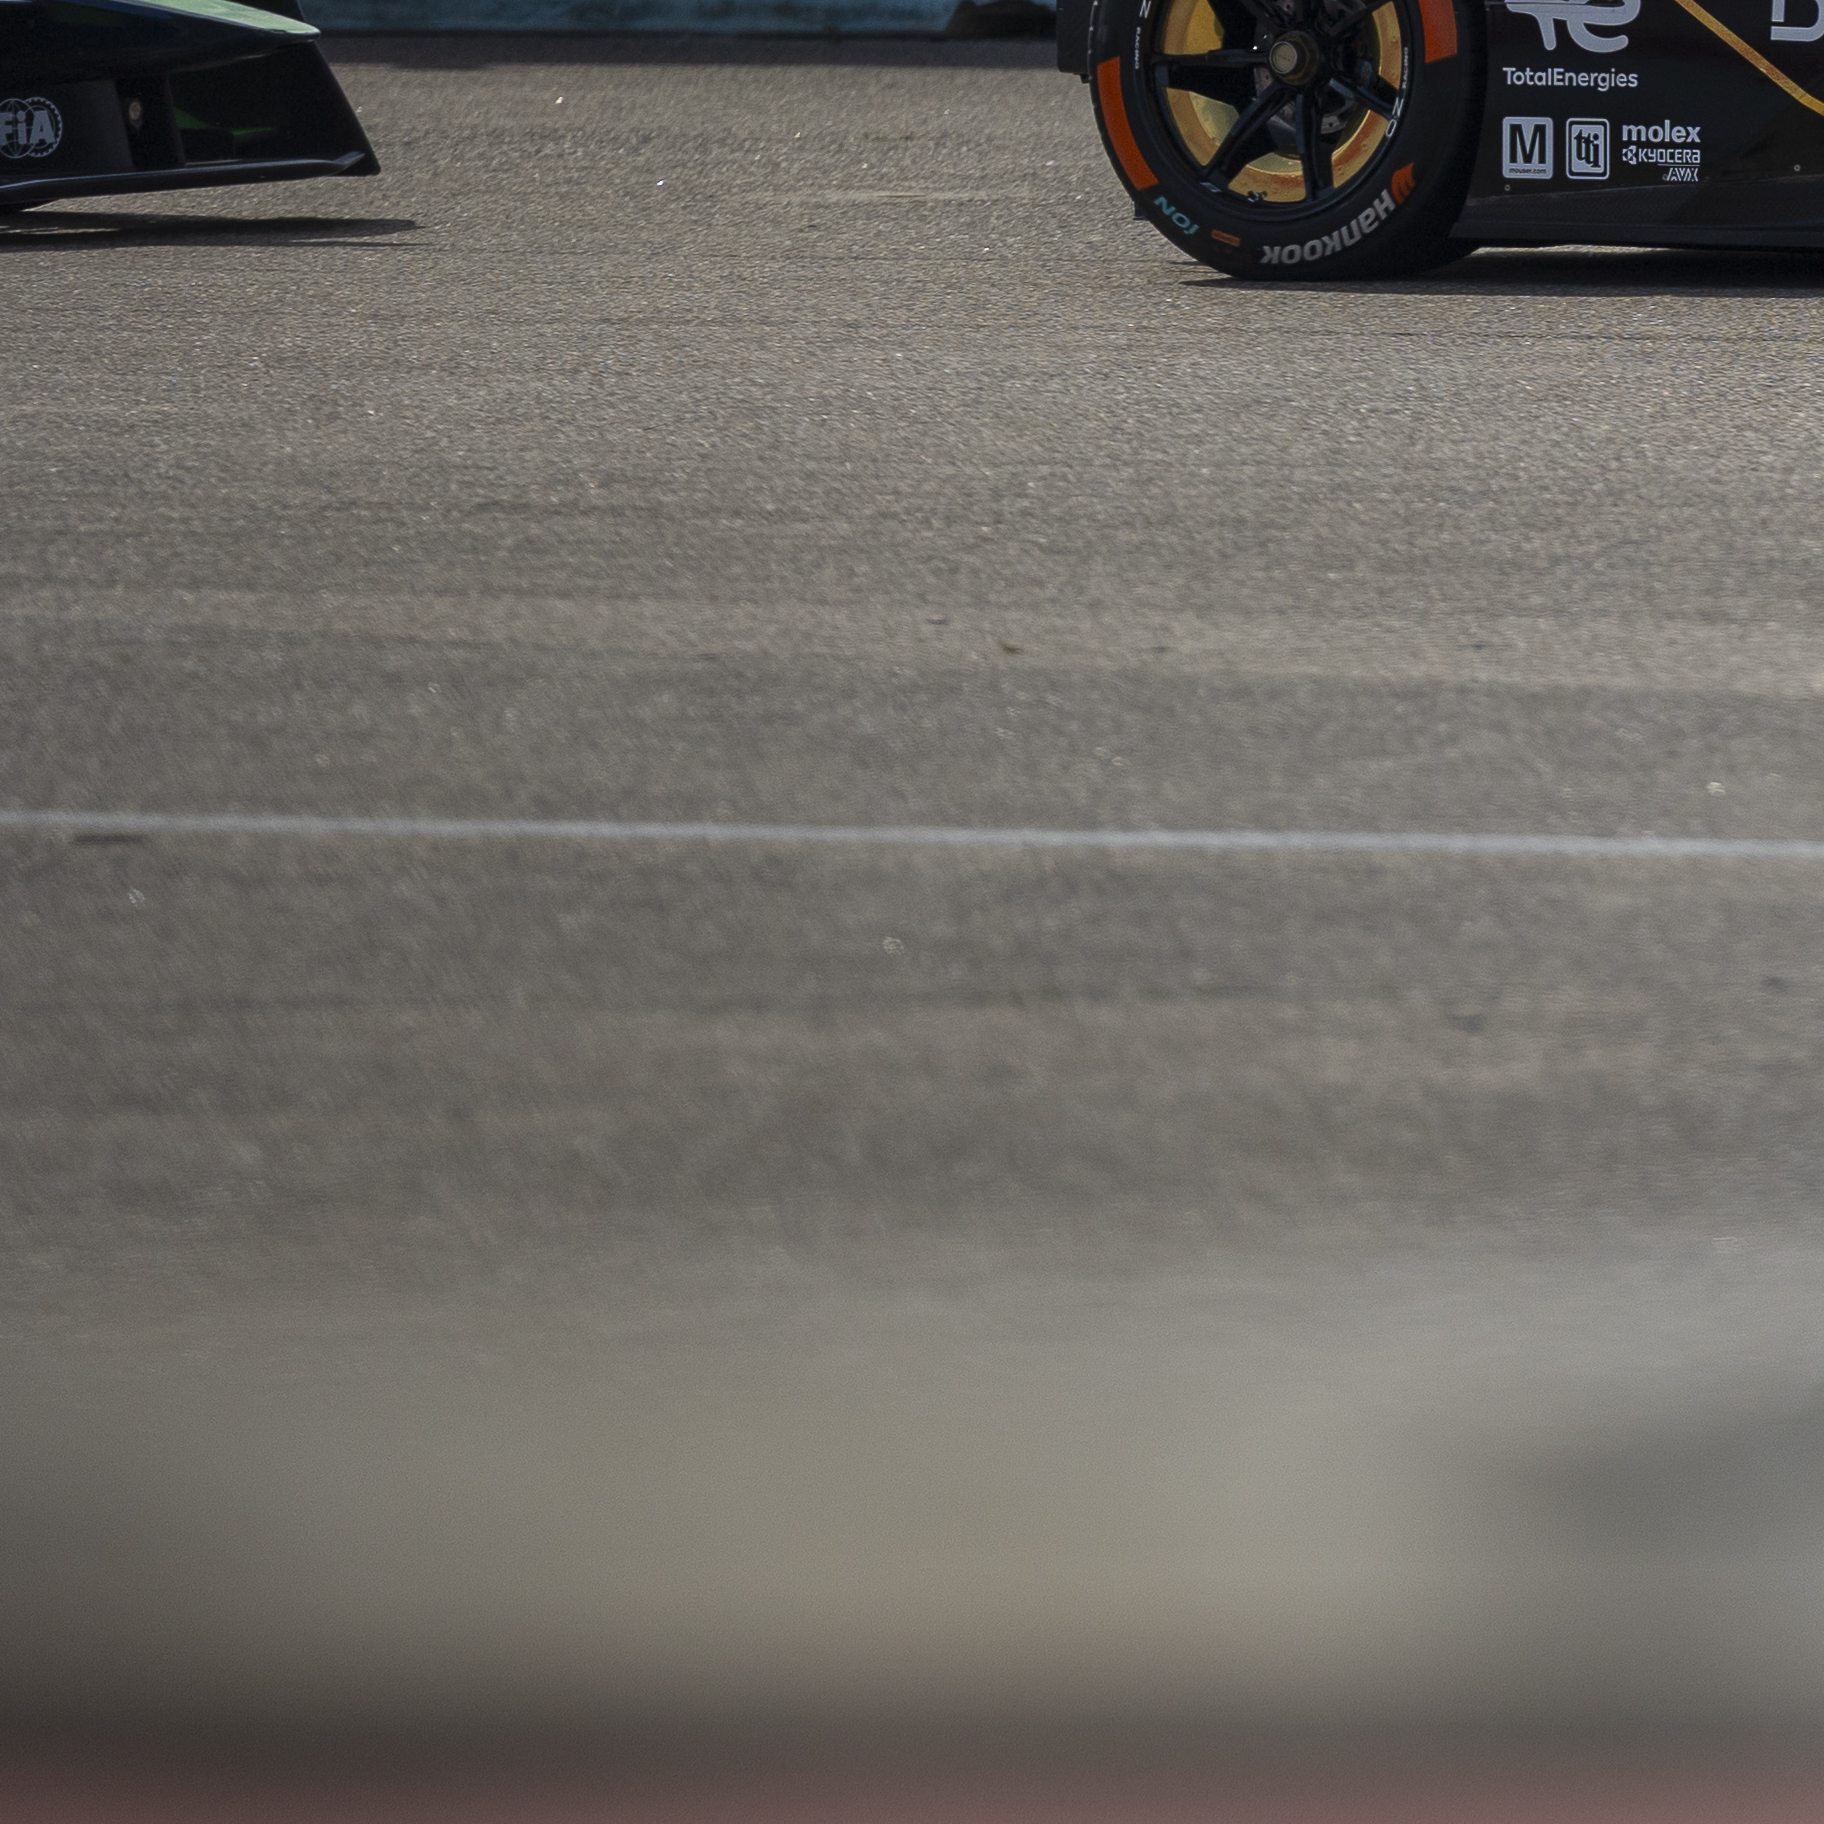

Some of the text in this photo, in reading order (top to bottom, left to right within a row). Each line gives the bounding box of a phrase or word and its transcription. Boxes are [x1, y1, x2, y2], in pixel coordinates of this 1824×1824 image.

[1503, 66, 1638, 91] TotalEnergies
[1622, 119, 1701, 143] molex
[1638, 147, 1701, 164] KYOCERA
